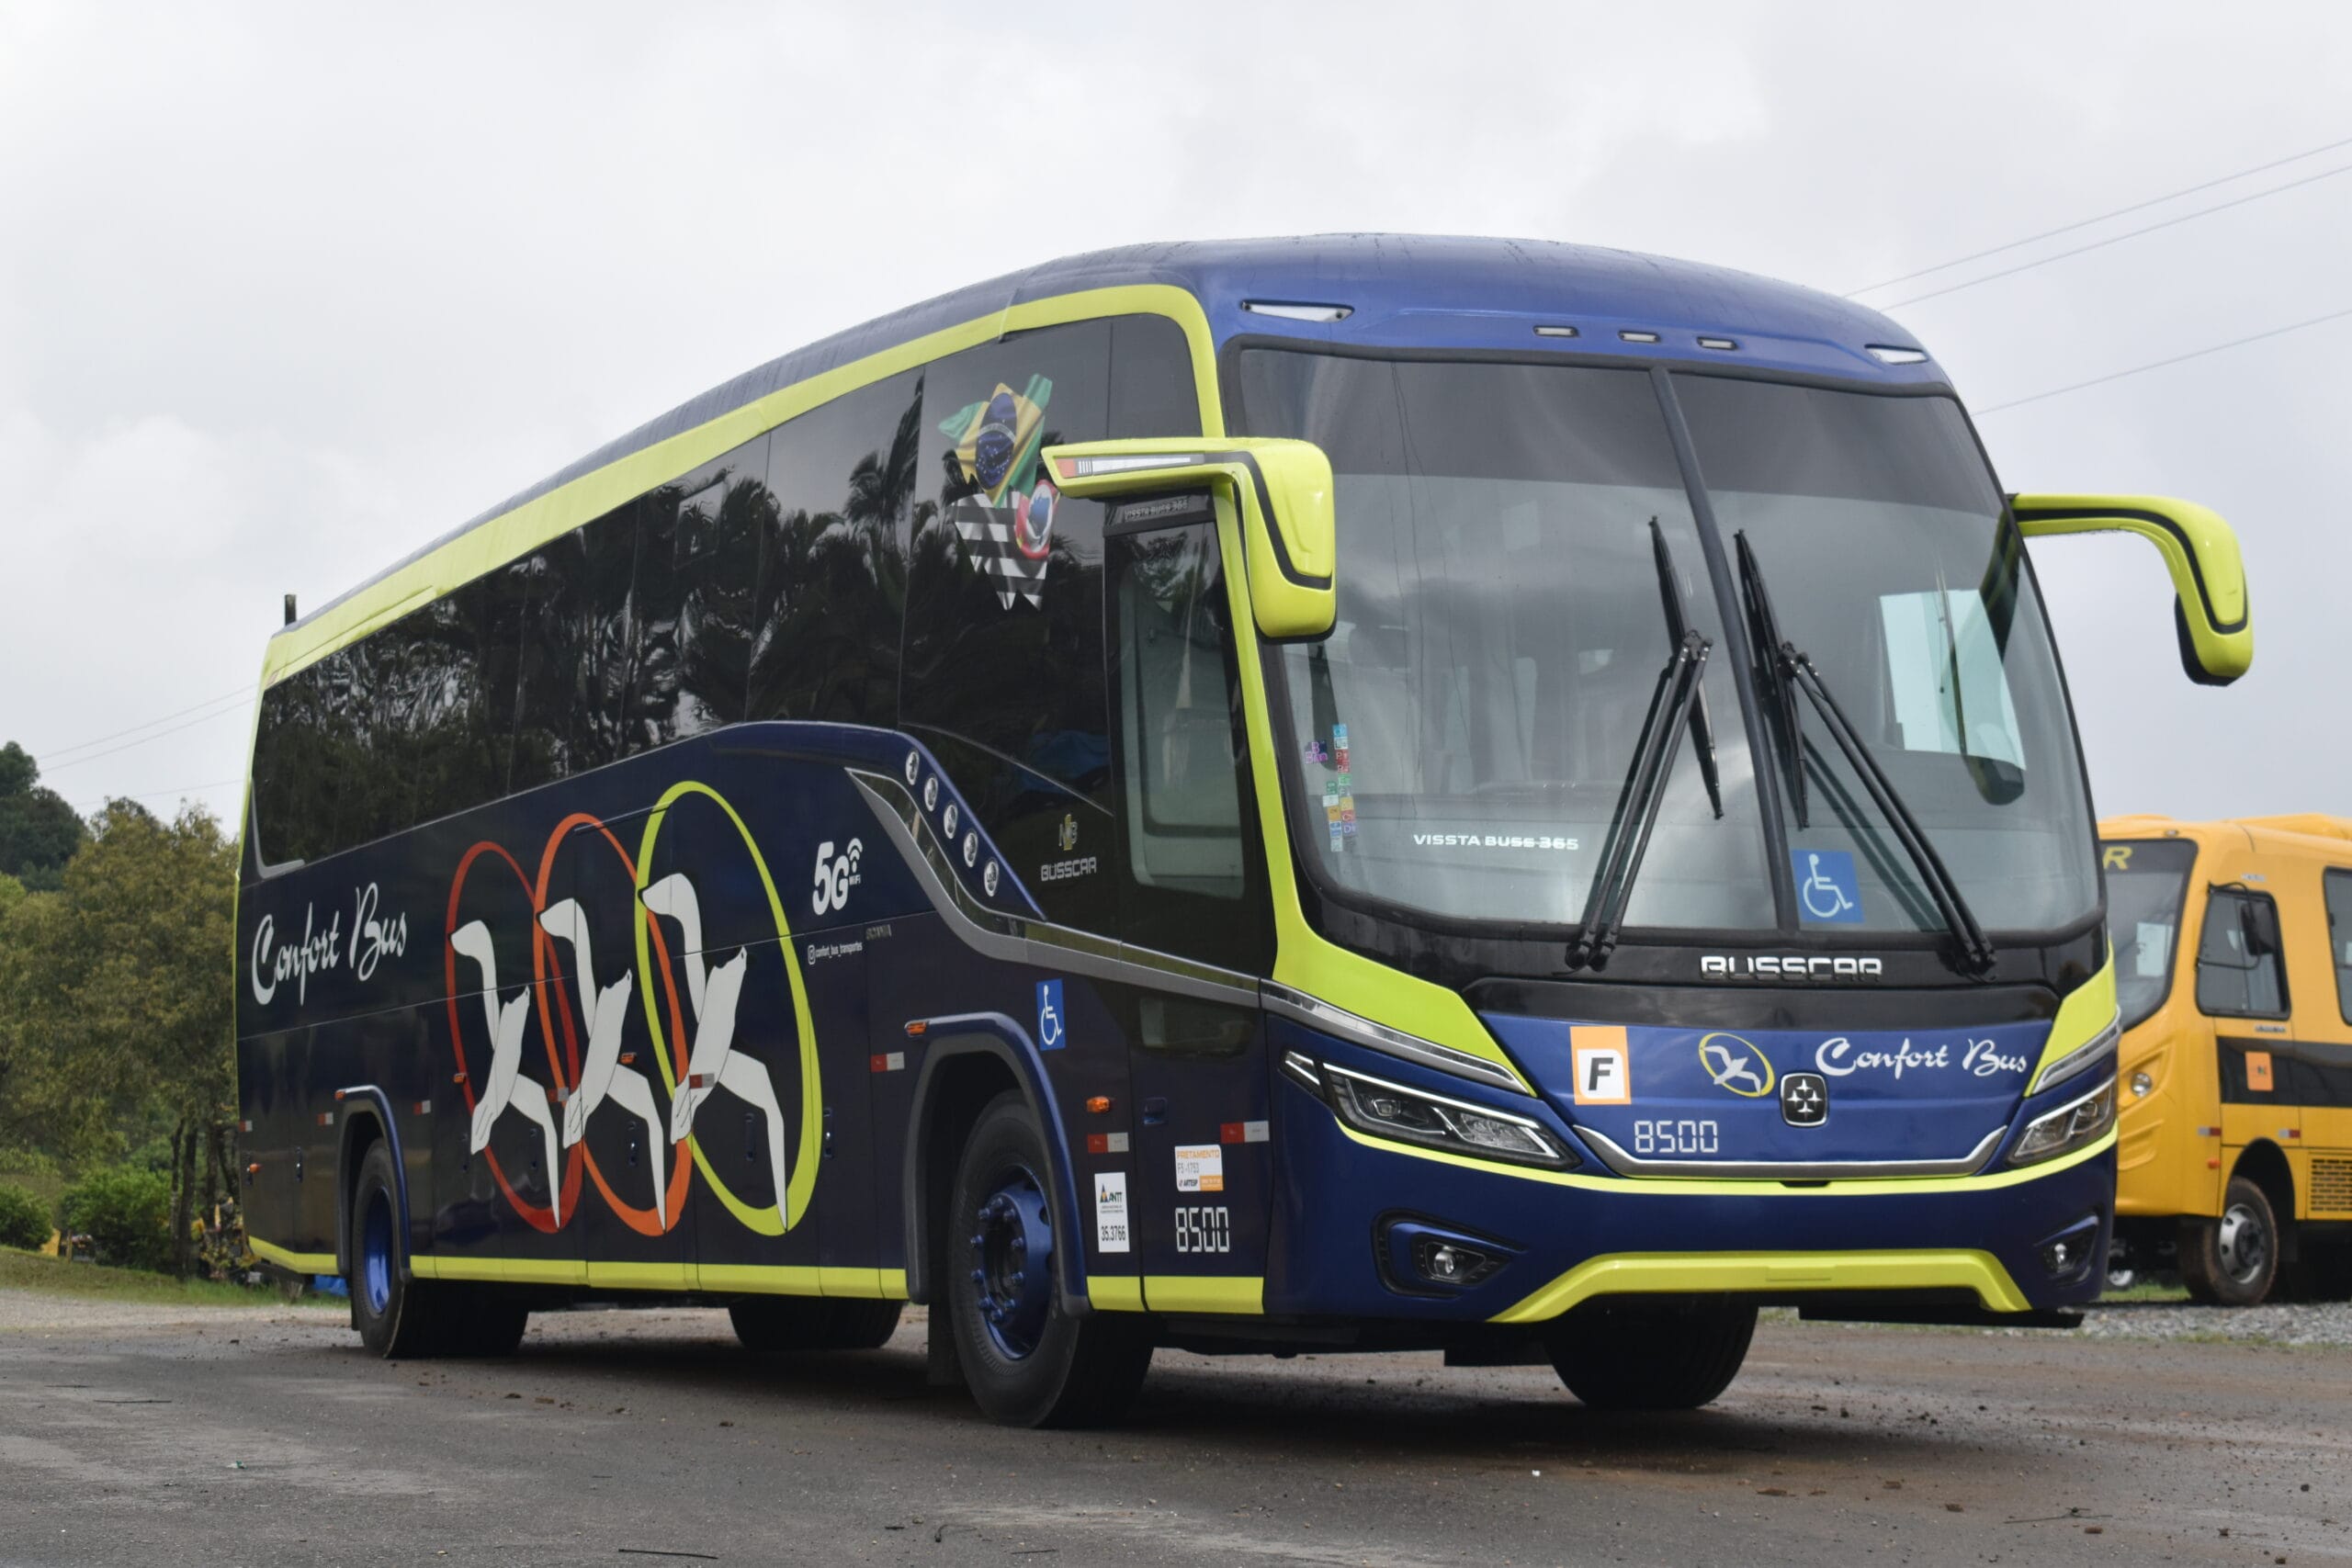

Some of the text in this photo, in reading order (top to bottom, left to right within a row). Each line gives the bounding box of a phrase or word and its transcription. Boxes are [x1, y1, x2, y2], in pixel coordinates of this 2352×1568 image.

[1413, 834, 1578, 851] VISSTA BUSS 365
[812, 841, 850, 916] 5G
[1041, 856, 1097, 882] BUSSCAR
[252, 882, 407, 1006] Confort Bus
[1701, 956, 1883, 980] BUSSCAR
[1589, 1057, 1613, 1091] F
[1815, 1037, 2027, 1079] Confort Bus
[1176, 1149, 1220, 1159] FRETAMENTO
[1634, 1120, 1719, 1154] 8500
[1175, 1206, 1230, 1253] 8500
